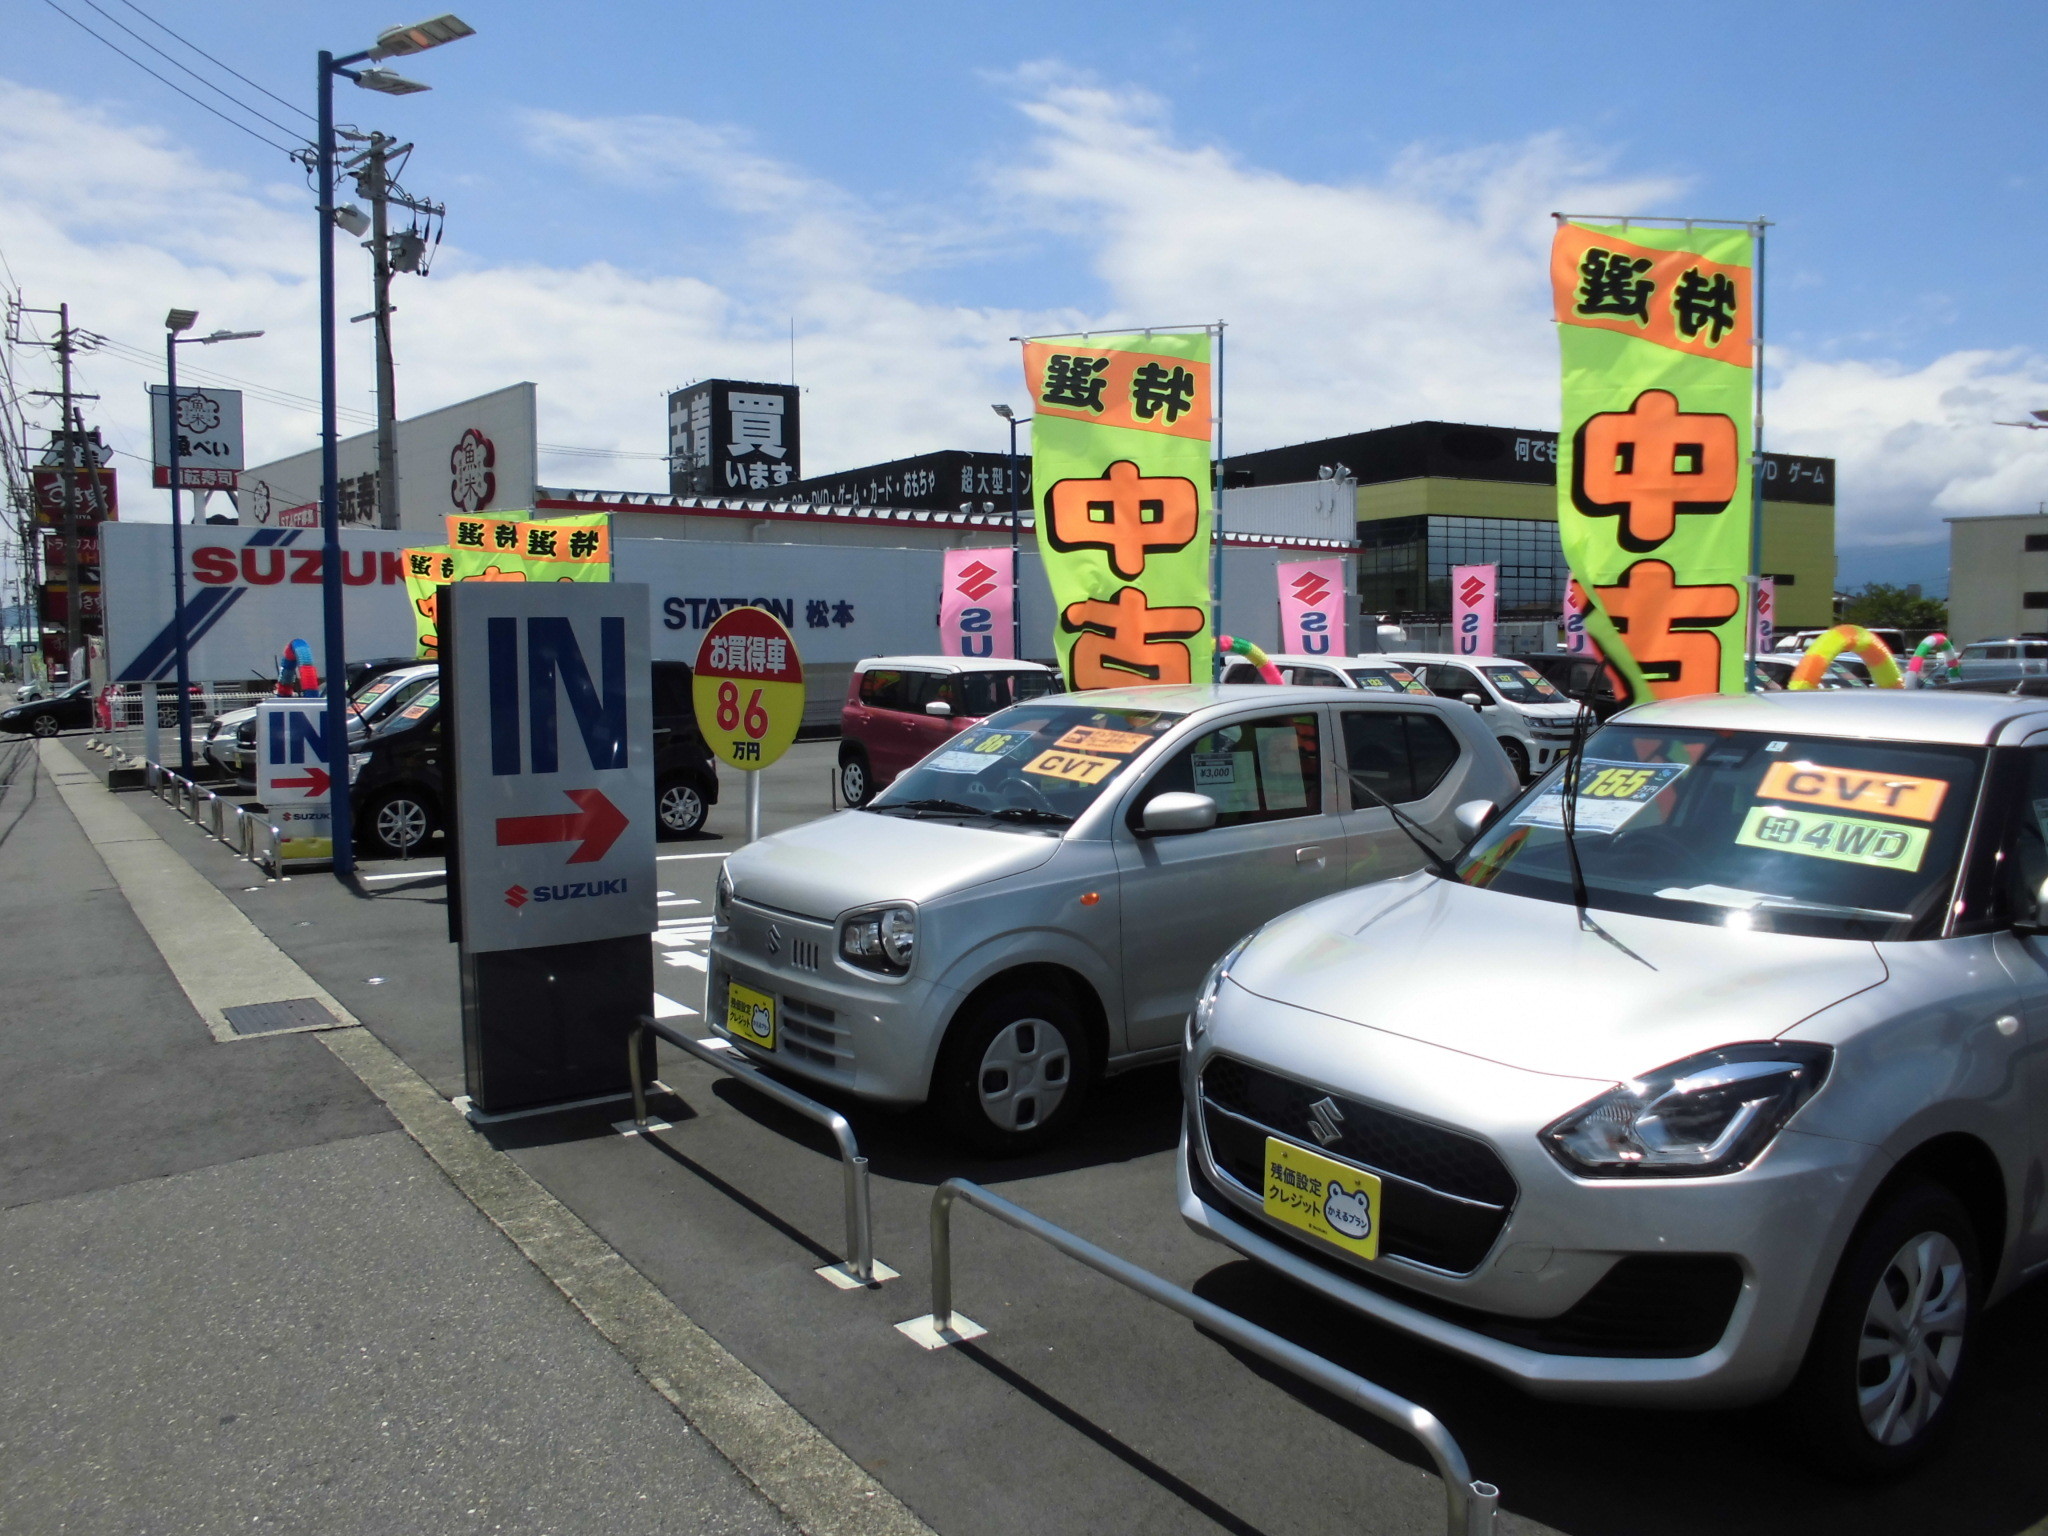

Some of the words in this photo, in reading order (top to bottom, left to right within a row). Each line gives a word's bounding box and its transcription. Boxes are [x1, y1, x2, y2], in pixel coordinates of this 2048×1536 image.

[726, 391, 787, 459] 買
[462, 442, 478, 501] 魚米
[725, 461, 793, 490] います
[1788, 462, 1825, 484] ゲーム
[664, 597, 793, 630] STATN
[806, 599, 854, 628] 松本
[709, 634, 787, 674] お買得車
[488, 616, 628, 776] IN
[716, 681, 769, 740] 86
[269, 711, 330, 765] IN
[732, 741, 761, 761] 万円
[1038, 755, 1105, 777] CVT
[1200, 767, 1230, 779] ¥3,000
[1581, 767, 1656, 798] 155
[1786, 771, 1918, 807] CVT
[1800, 820, 1912, 861] 4WD
[532, 878, 628, 903] SUZUKI
[1270, 1161, 1323, 1198] 残価設定
[1269, 1184, 1321, 1217] クレジット
[1327, 1205, 1368, 1230] かえるプラン
